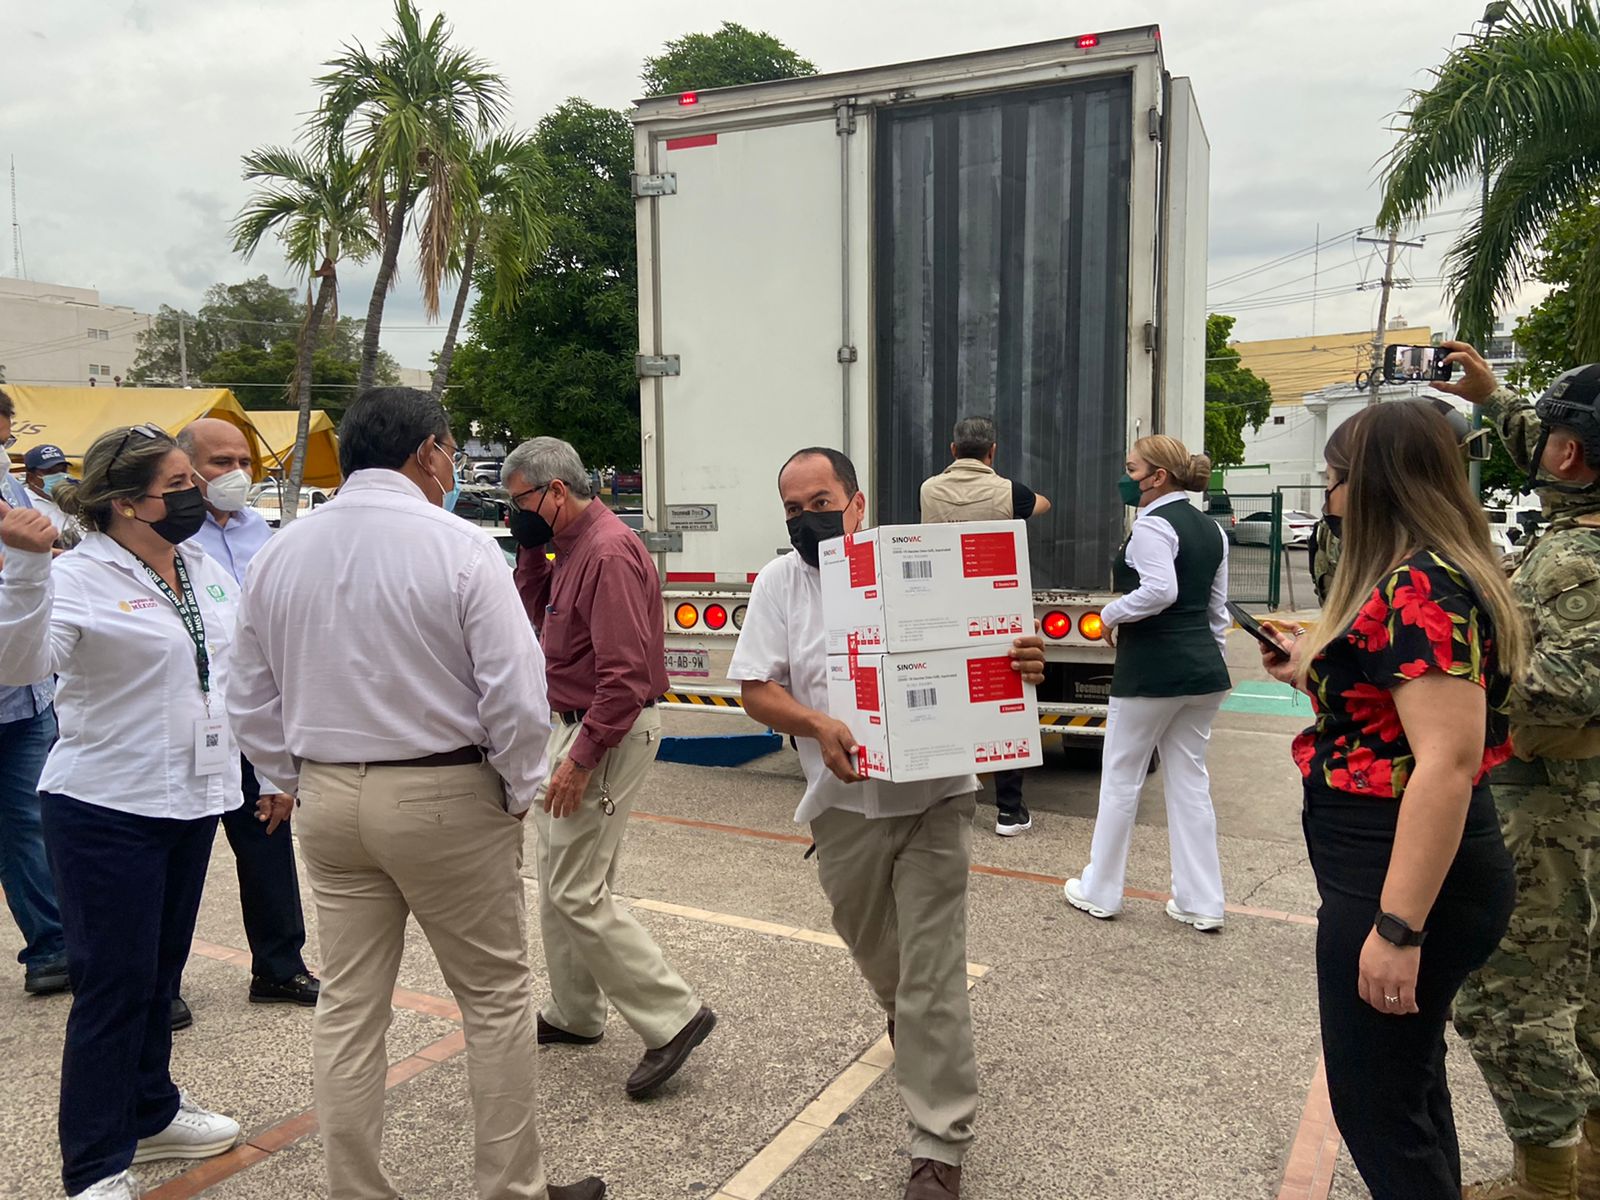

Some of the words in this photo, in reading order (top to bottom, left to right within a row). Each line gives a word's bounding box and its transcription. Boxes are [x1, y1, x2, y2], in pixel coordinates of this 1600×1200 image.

[166, 590, 182, 607] IMSS
[184, 590, 196, 606] IMSS
[193, 614, 203, 631] IMSS
[896, 662, 927, 671] SINOVAC
